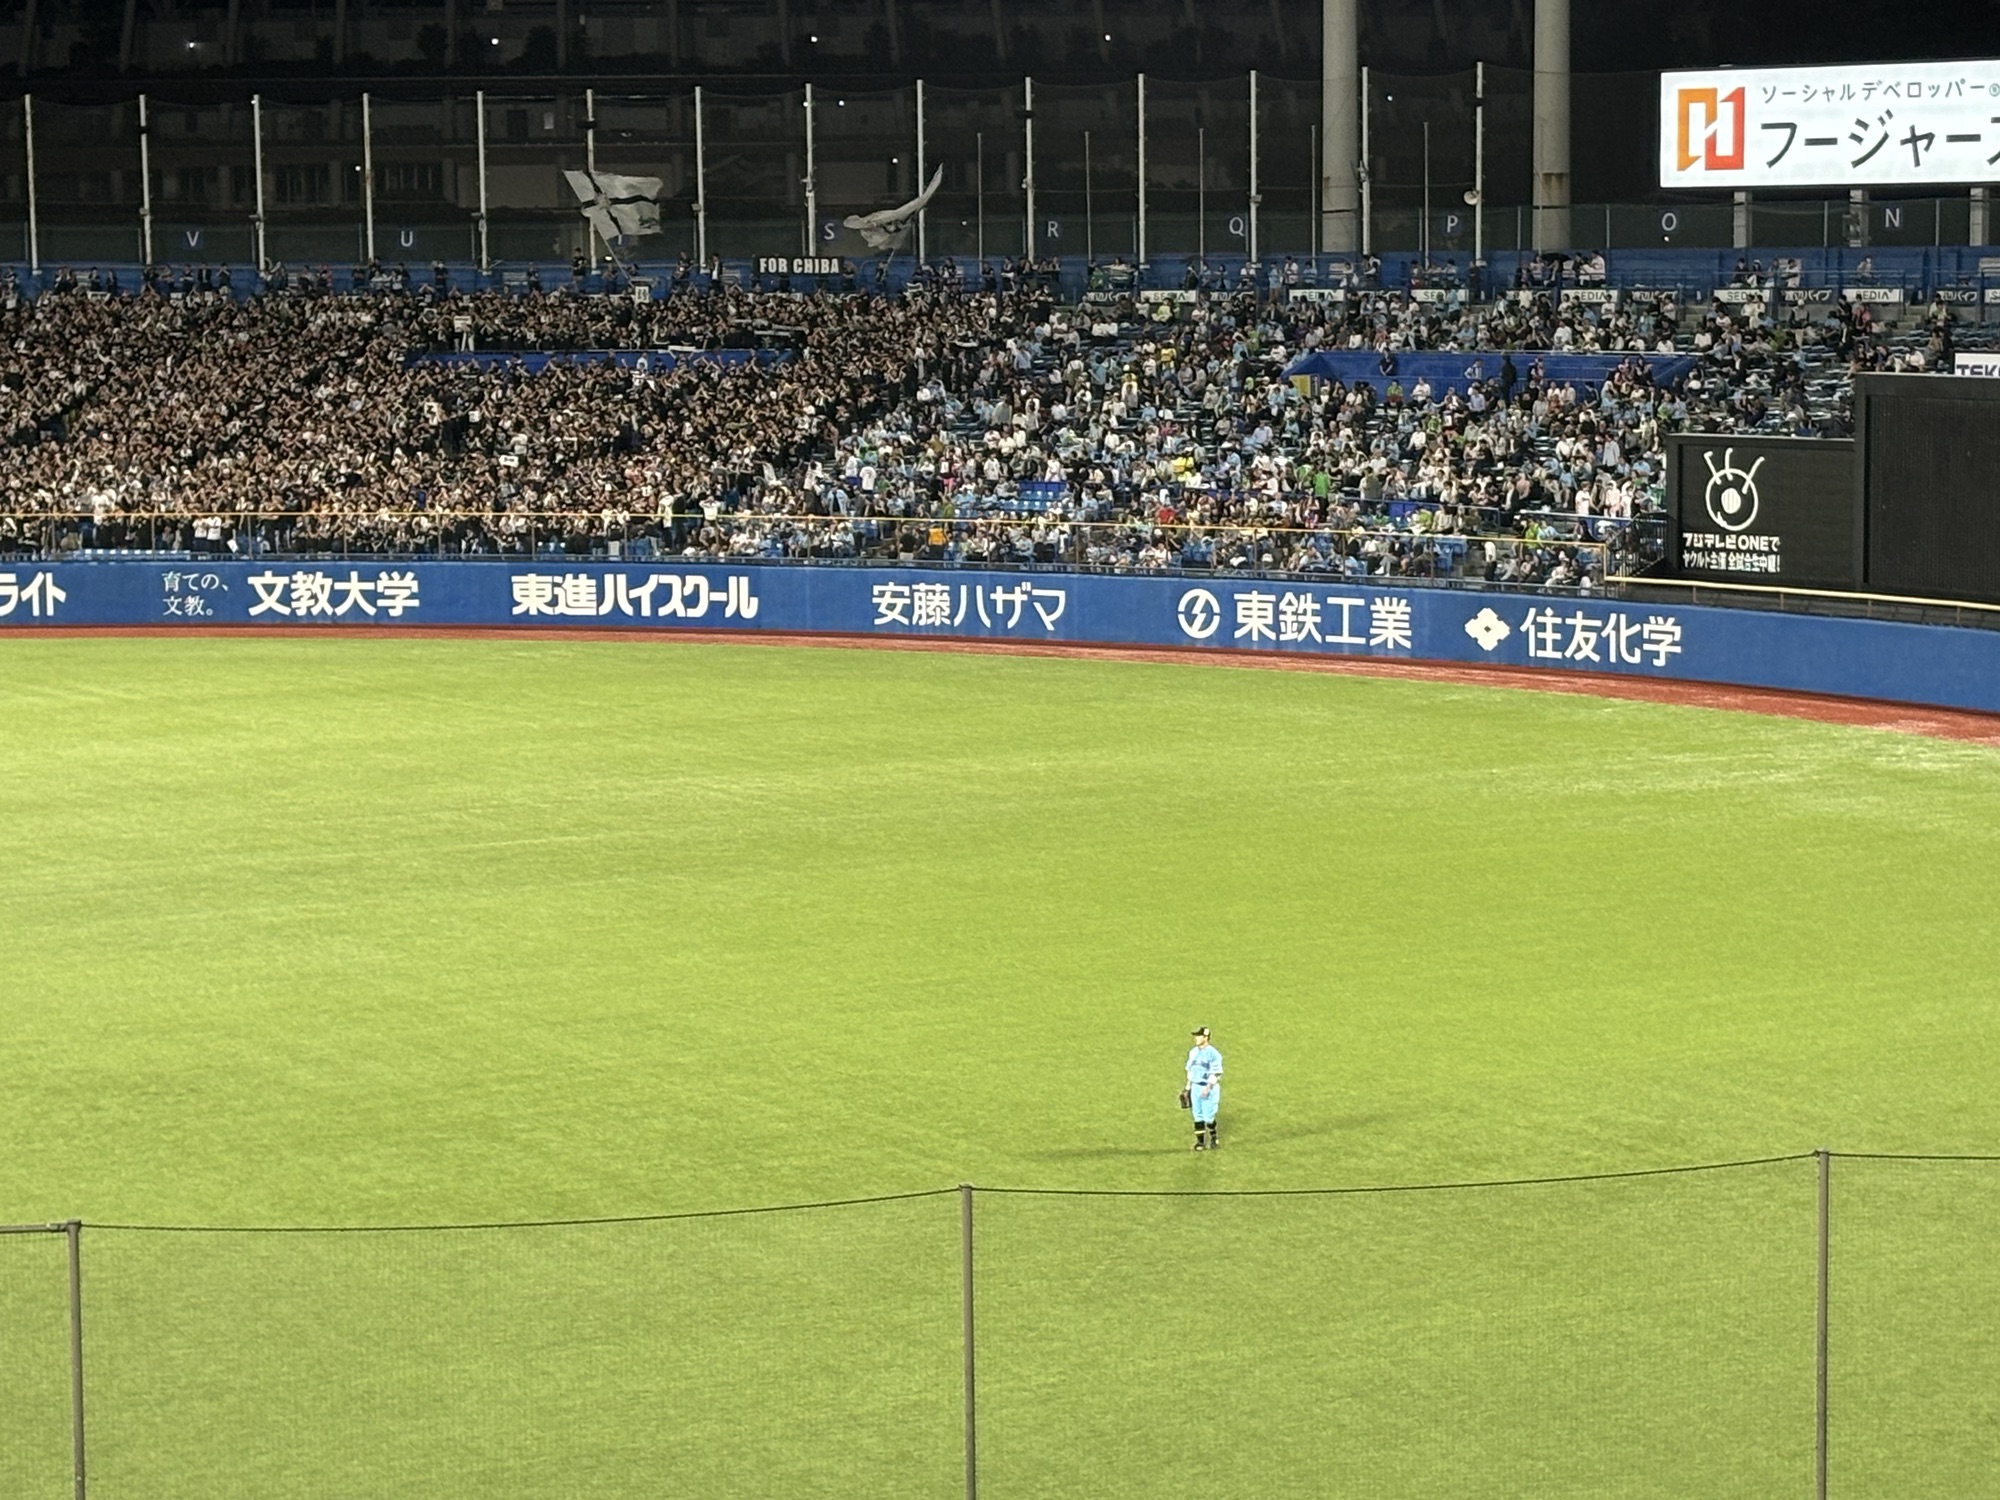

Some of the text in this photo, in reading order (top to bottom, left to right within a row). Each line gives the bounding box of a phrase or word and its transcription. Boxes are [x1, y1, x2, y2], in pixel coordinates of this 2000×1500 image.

[1229, 216, 1244, 237] Q
[1447, 215, 1458, 233] P
[1885, 208, 1900, 228] N
[186, 231, 199, 247] V
[400, 231, 413, 247] U
[824, 223, 835, 240] S
[1047, 221, 1059, 238] R
[759, 257, 840, 274] FOR CHIBA
[161, 571, 229, 592] 育ての、
[247, 570, 420, 617] 文教大学
[511, 573, 759, 619] 東進ハイスクール
[162, 595, 214, 616] 文教。
[872, 581, 1067, 631] 安藤ハザマ
[1233, 590, 1413, 649] 東鉄工業
[1519, 606, 1683, 667] 住友化学
